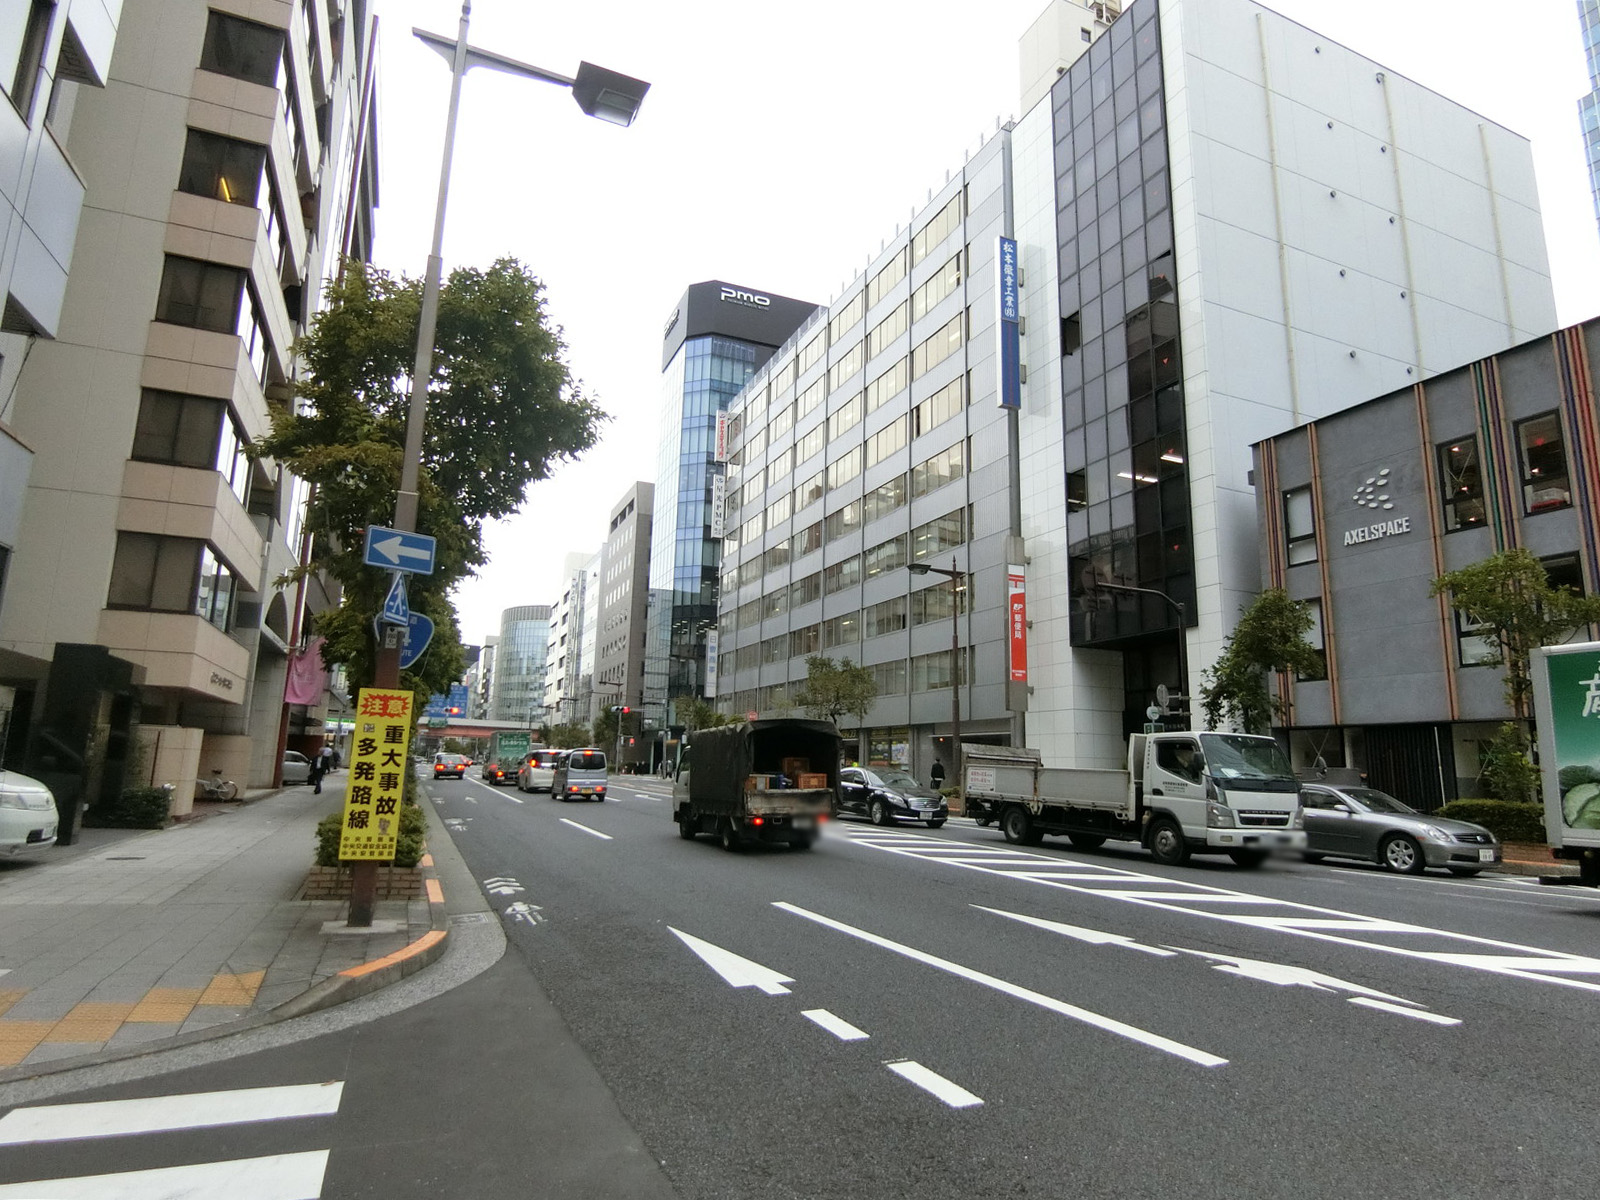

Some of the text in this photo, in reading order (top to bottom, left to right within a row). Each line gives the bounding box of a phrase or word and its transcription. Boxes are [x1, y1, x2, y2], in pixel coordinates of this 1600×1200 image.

[1344, 516, 1411, 547] AXELSPACE
[366, 698, 404, 714] 注意
[347, 737, 378, 830] 多発路線
[375, 725, 405, 816] 重大事故
